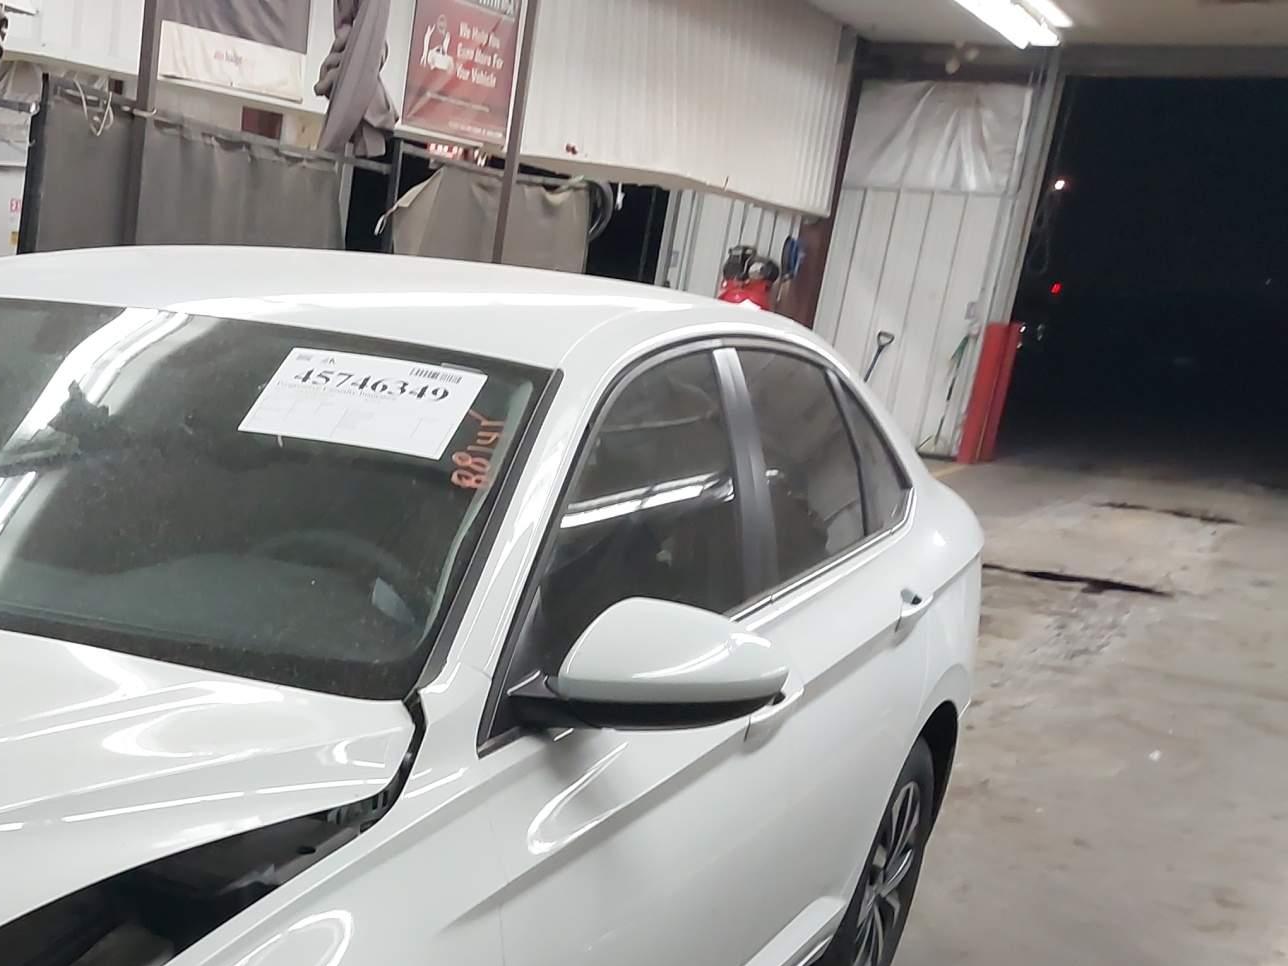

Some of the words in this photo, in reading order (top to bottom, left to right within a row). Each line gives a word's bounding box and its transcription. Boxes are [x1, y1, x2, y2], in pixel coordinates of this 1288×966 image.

[492, 53, 503, 69] For
[472, 67, 496, 88] Vehicle
[294, 367, 449, 401] 45746349
